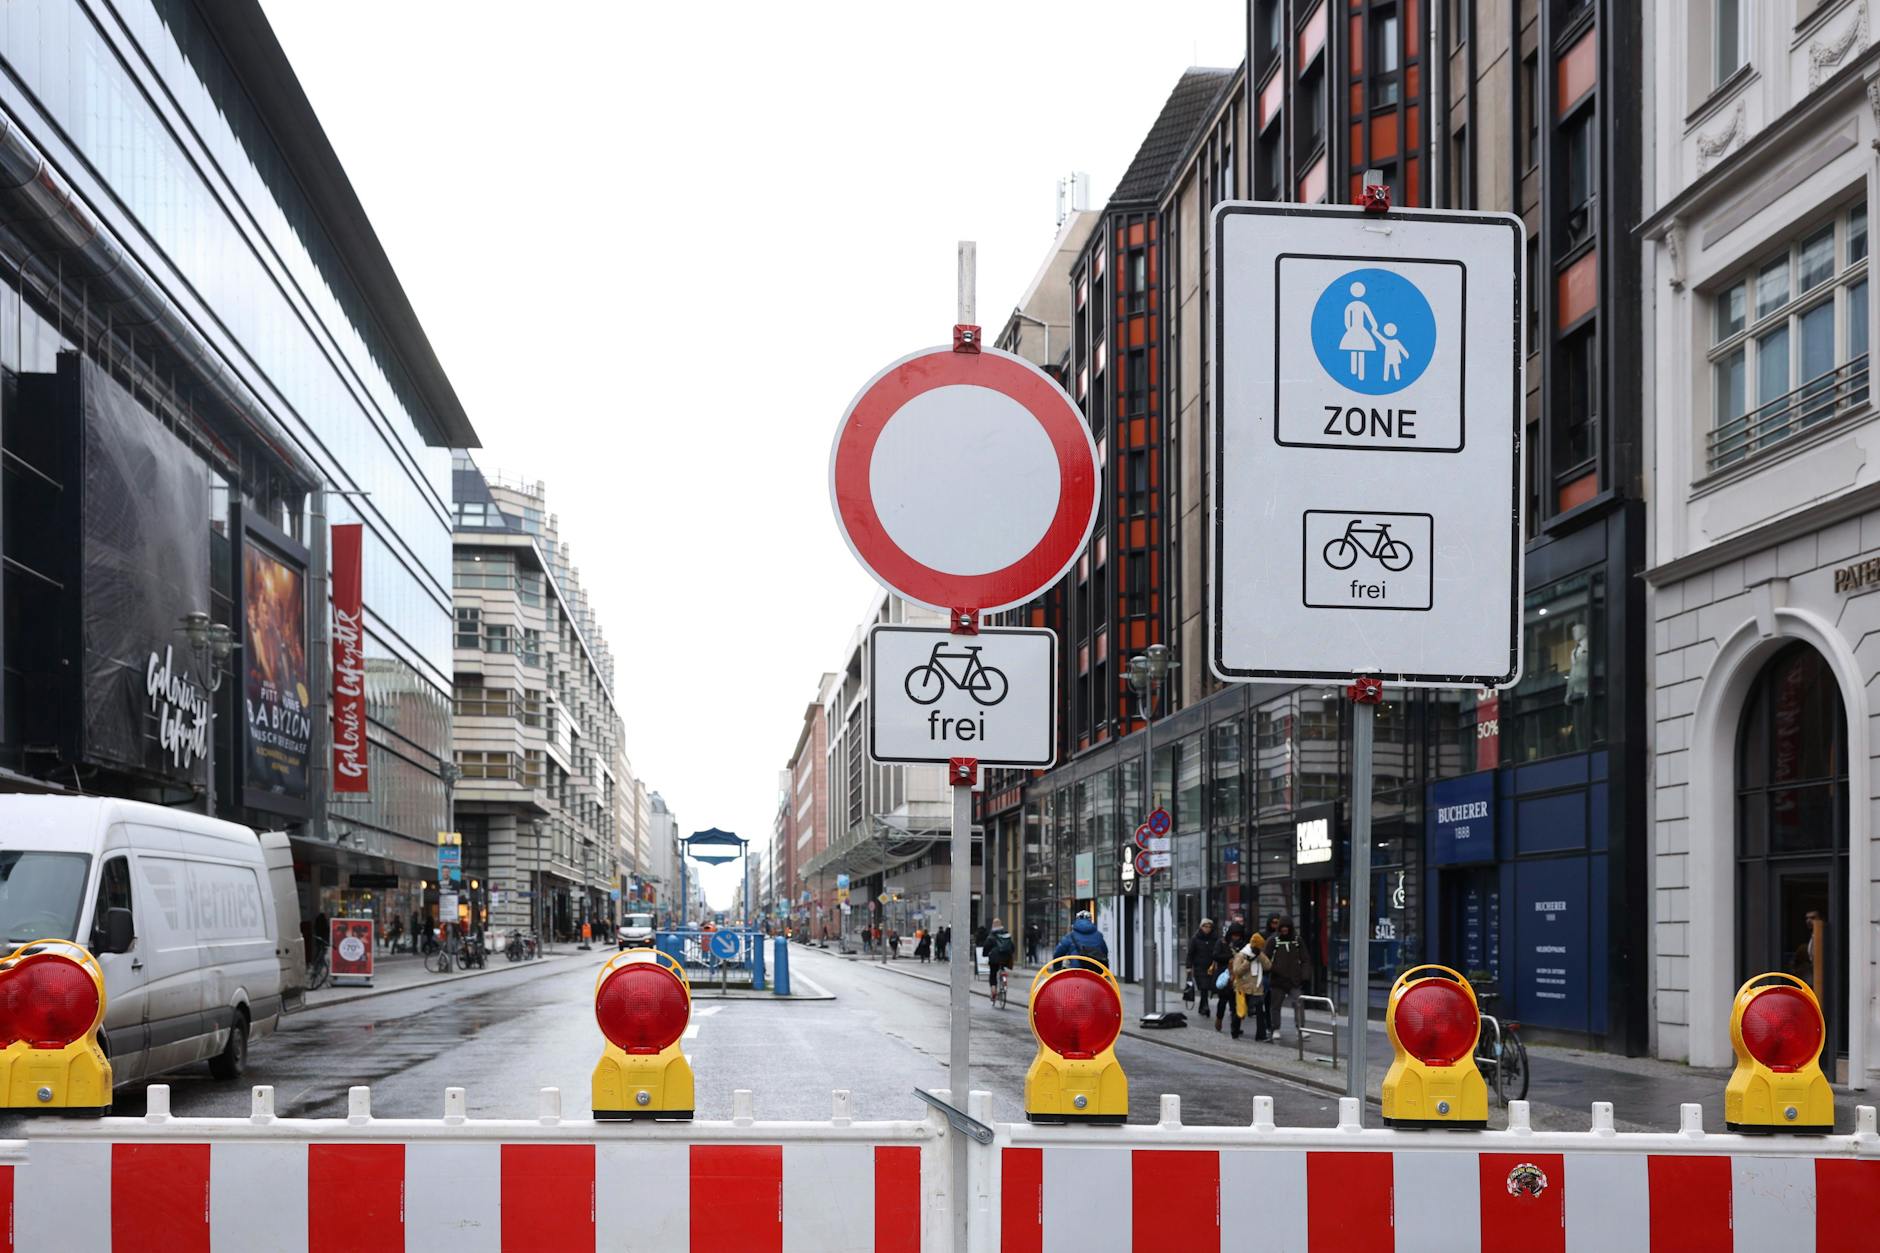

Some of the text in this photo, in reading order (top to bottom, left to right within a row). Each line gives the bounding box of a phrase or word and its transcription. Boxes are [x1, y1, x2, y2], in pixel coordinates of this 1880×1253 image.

[1323, 405, 1417, 439] ZONE
[1834, 557, 1880, 593] PATE
[1350, 579, 1386, 599] frei
[928, 709, 985, 742] frei
[1477, 719, 1499, 739] 50%
[1438, 801, 1488, 824] BUCHERER
[1454, 826, 1471, 839] 1888
[186, 869, 258, 931] Hermes
[1375, 925, 1395, 939] SALE
